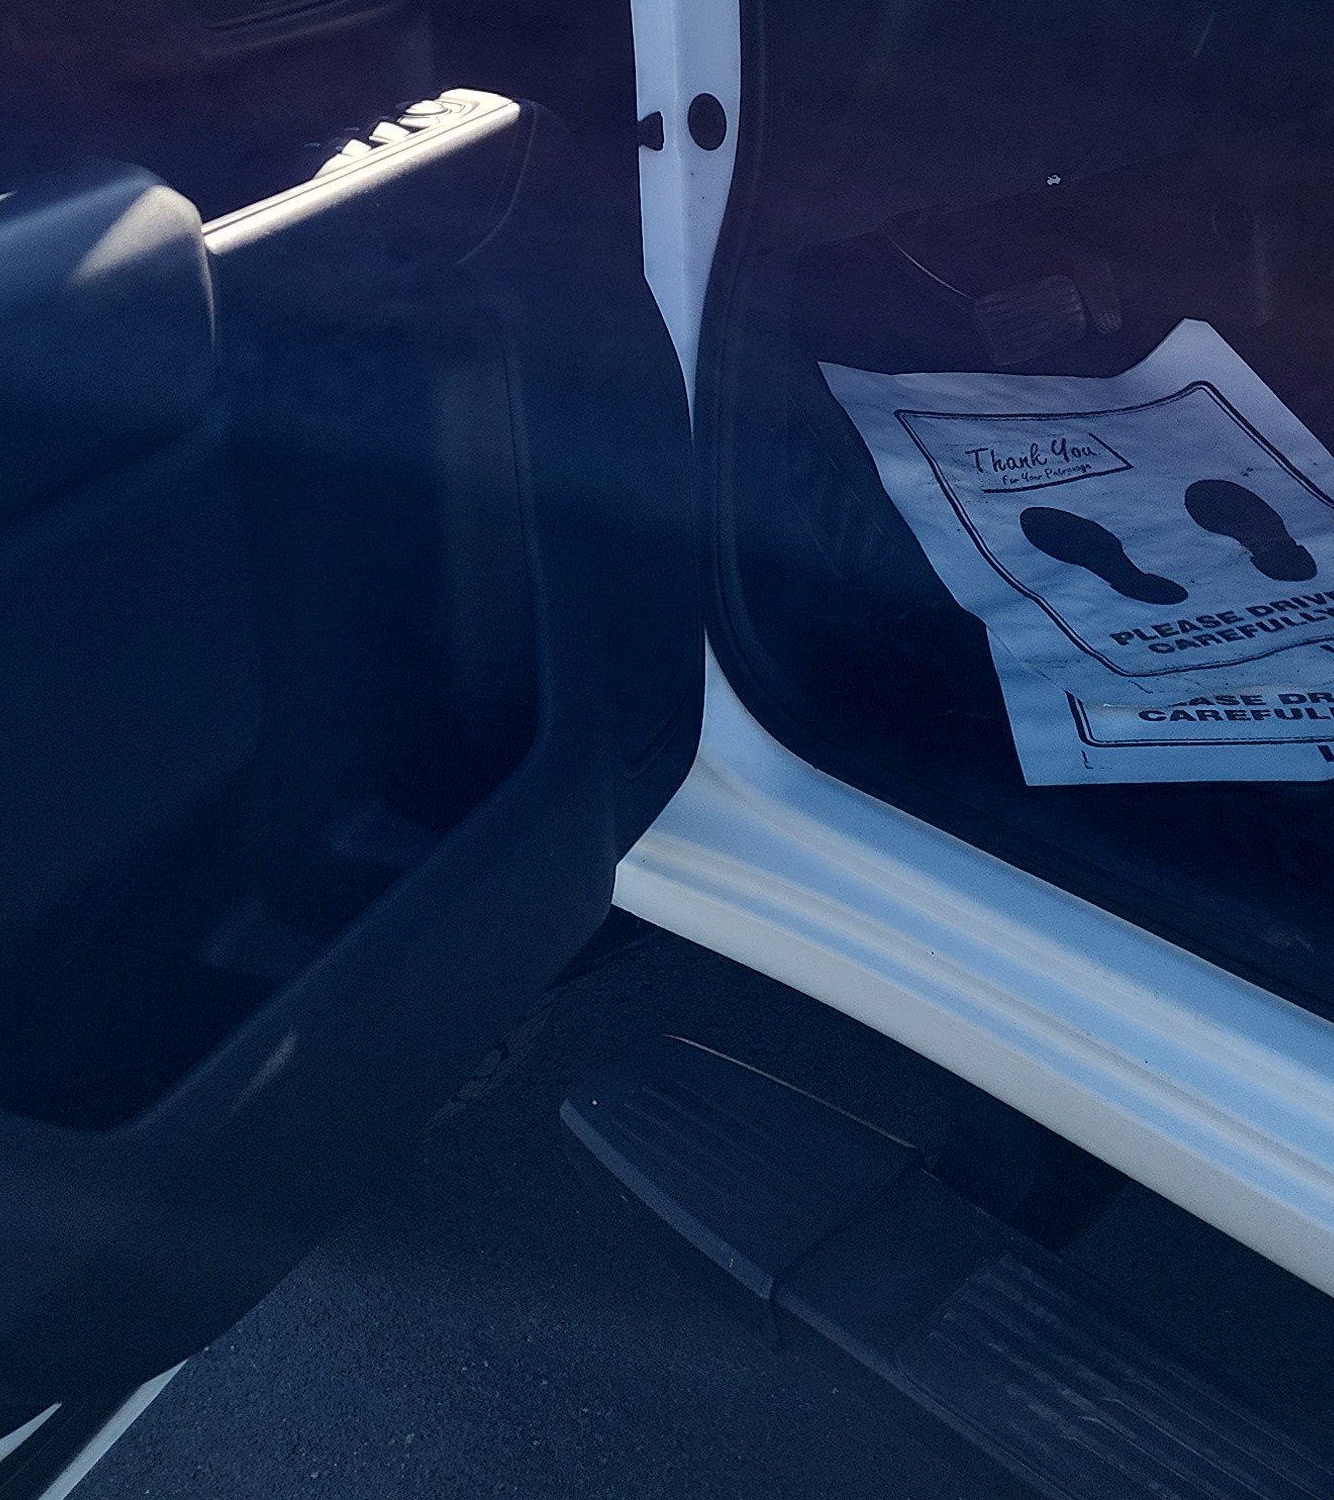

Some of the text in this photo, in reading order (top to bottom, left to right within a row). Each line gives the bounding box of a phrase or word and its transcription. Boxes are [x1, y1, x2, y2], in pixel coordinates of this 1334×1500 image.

[965, 438, 1097, 473] Thank You
[1109, 611, 1244, 646] PLEASE
[1169, 694, 1267, 707] ASE
